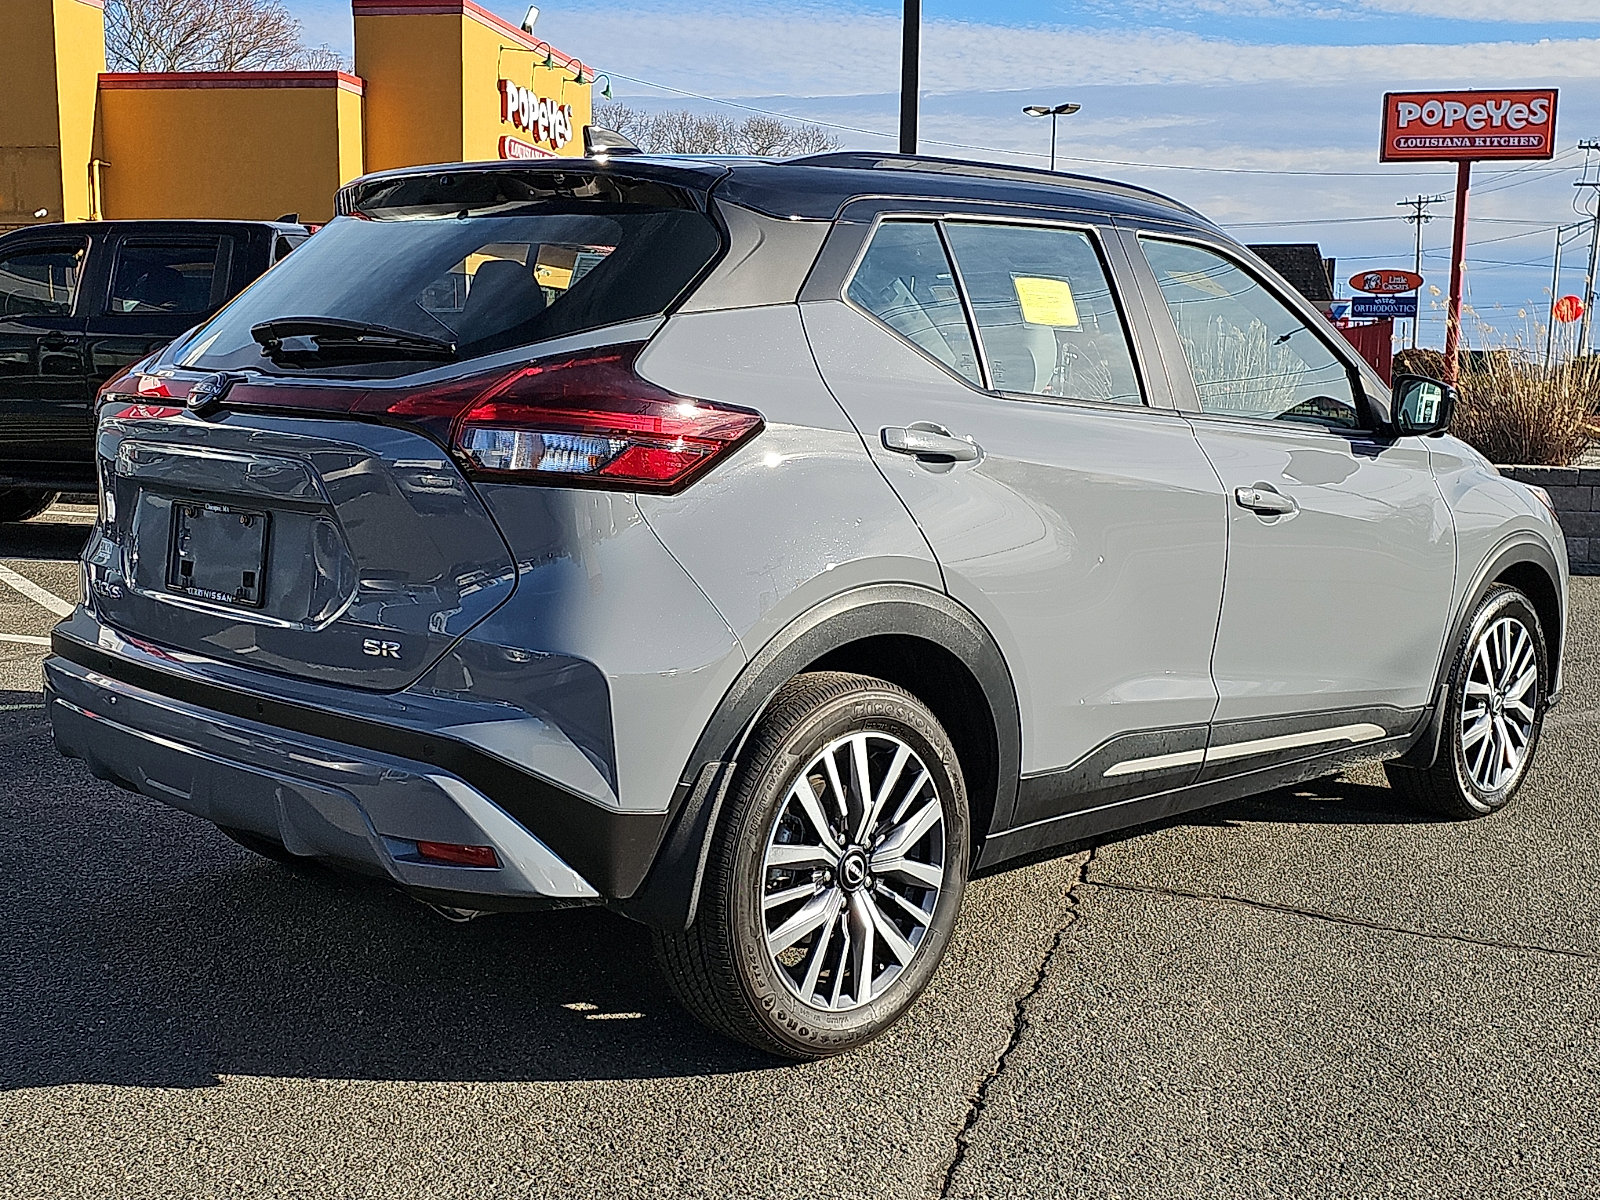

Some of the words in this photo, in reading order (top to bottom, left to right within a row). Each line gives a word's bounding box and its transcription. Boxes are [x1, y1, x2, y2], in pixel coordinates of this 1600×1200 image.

[1400, 136, 1471, 148] LOUISIANA
[1474, 136, 1540, 147] KITCHEN
[1353, 304, 1416, 313] ORTHODONTICS
[362, 638, 402, 659] SR
[854, 702, 944, 749] Firestone
